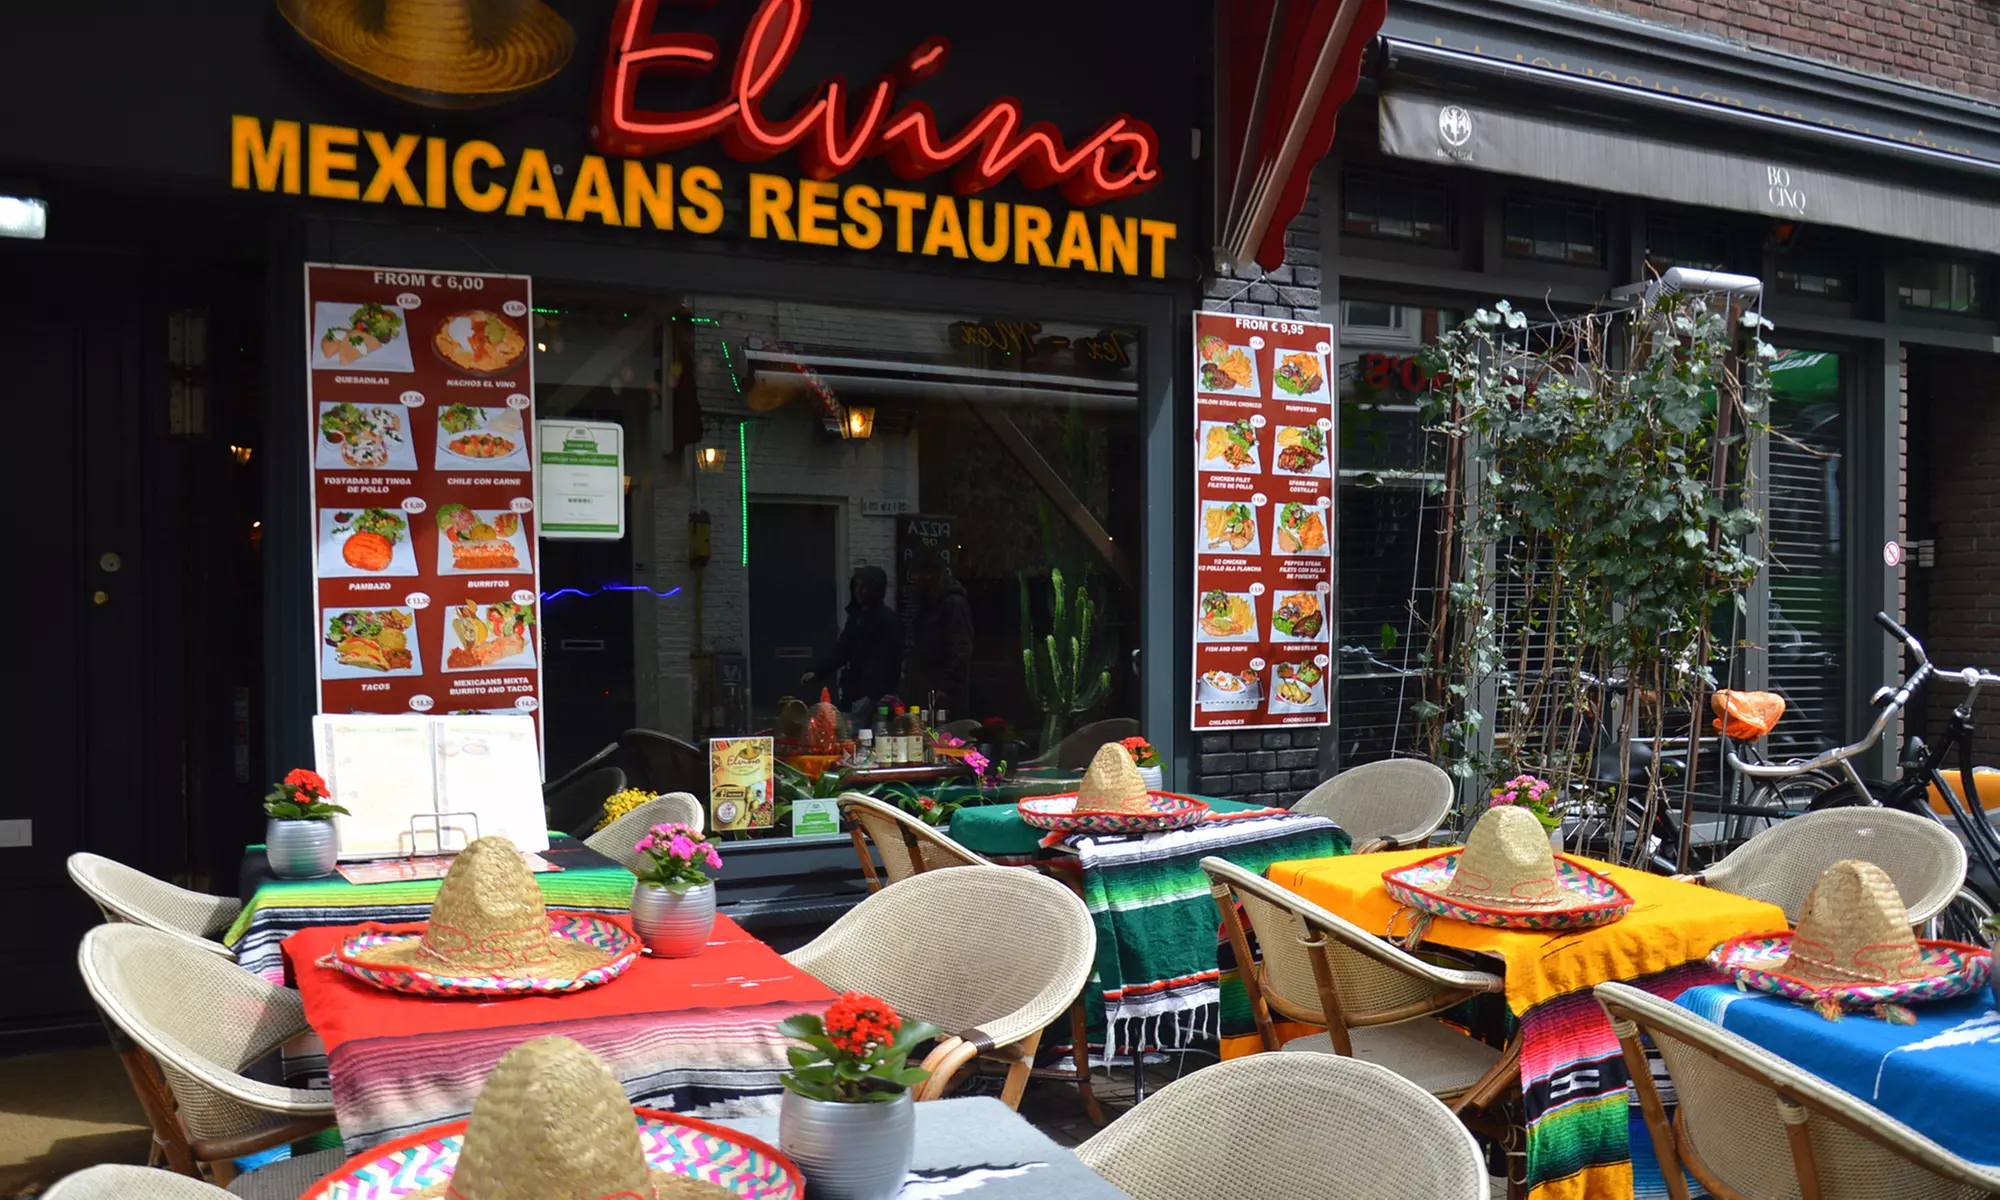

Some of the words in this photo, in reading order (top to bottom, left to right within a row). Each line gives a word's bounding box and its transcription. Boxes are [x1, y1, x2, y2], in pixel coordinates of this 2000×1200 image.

[1767, 166, 1790, 187] BO
[231, 114, 724, 234] MEXICAANS
[748, 172, 1177, 279] RESTAURANT
[374, 271, 426, 287] FROM
[431, 275, 442, 287] €
[447, 275, 485, 291] 6,00
[1235, 318, 1268, 331] FROM
[1271, 323, 1279, 332] €
[1280, 323, 1305, 335] 9,95
[335, 375, 390, 385] QUESADILAS
[446, 379, 482, 388] NACHOS
[495, 381, 516, 389] VINO
[324, 476, 370, 486] TOSTADAS
[371, 477, 383, 485] DE
[385, 477, 412, 485] TINGA
[447, 477, 472, 485] CHILE
[473, 477, 491, 485] CON
[493, 478, 521, 486] CARNE
[347, 485, 358, 493] DE
[348, 582, 391, 591] PAMBAZO
[467, 580, 510, 588] BURRITOS
[361, 682, 390, 691] TACOS
[453, 678, 502, 687] MEXICAANS
[503, 676, 529, 685] MIXTA
[449, 686, 486, 695] BURRITO
[487, 685, 505, 693] AND
[506, 684, 534, 693] TACOS
